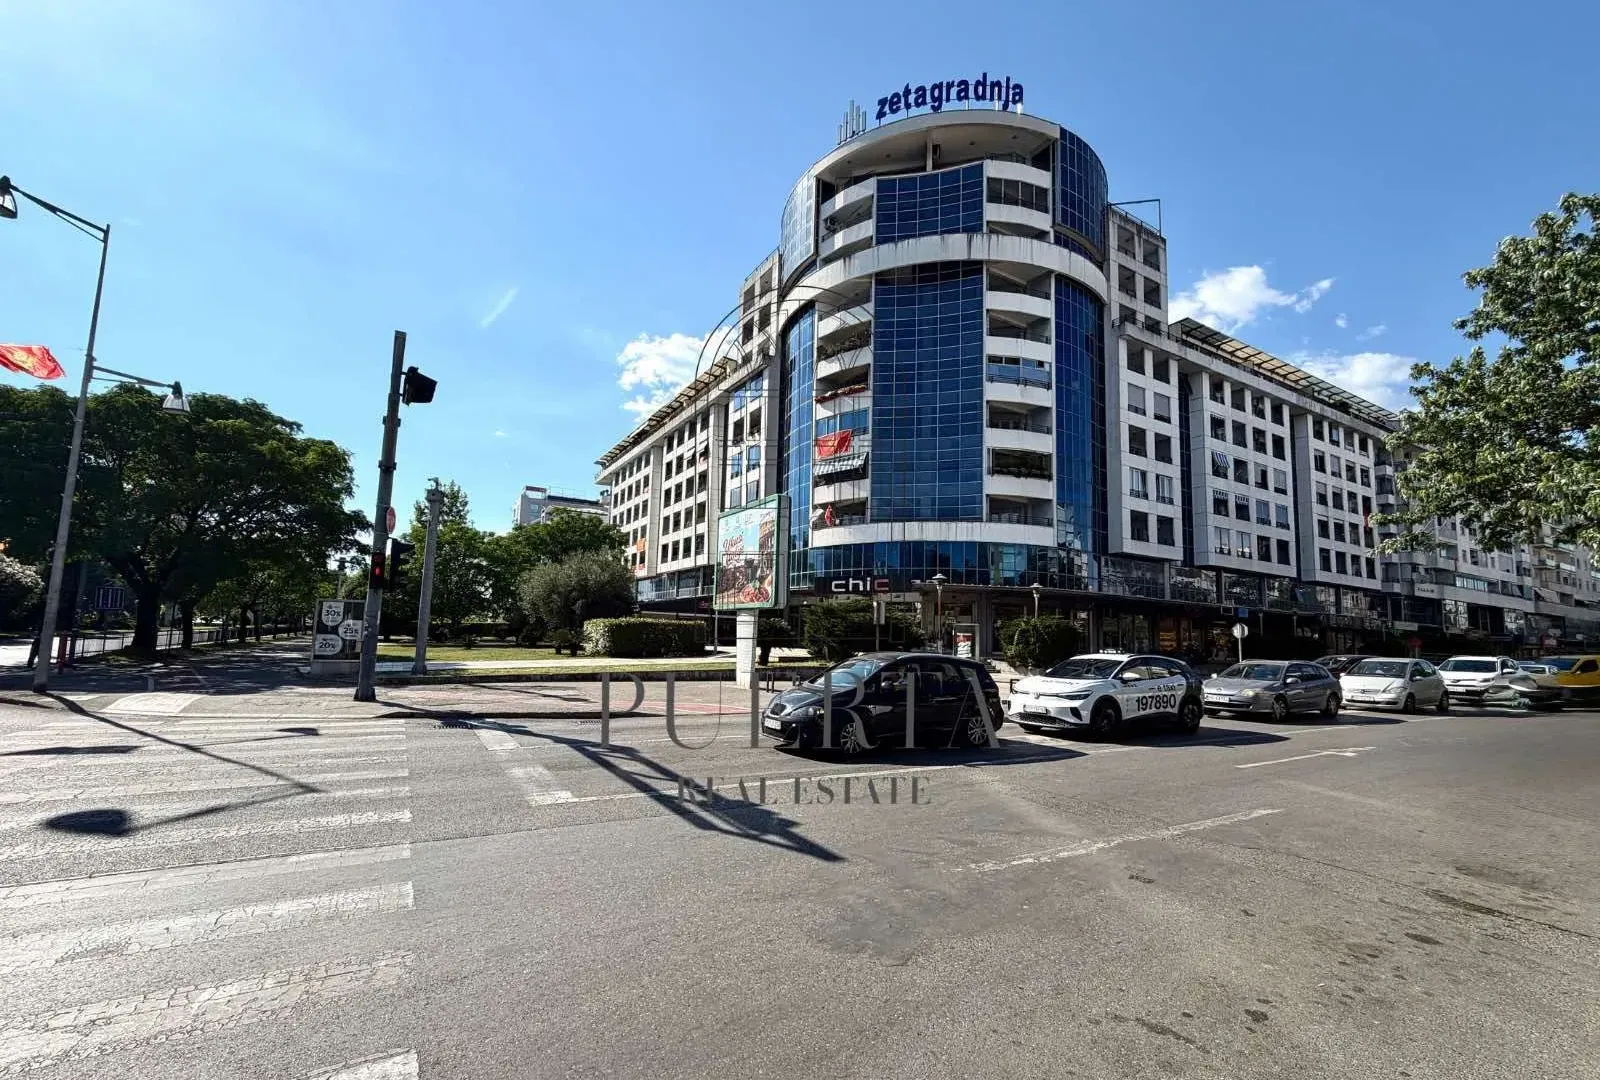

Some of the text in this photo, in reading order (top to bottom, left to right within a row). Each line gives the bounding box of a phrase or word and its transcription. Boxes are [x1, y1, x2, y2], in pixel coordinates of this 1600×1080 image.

[875, 72, 1024, 120] zetagradnja
[831, 577, 889, 592] chic
[1135, 693, 1177, 712] 197890
